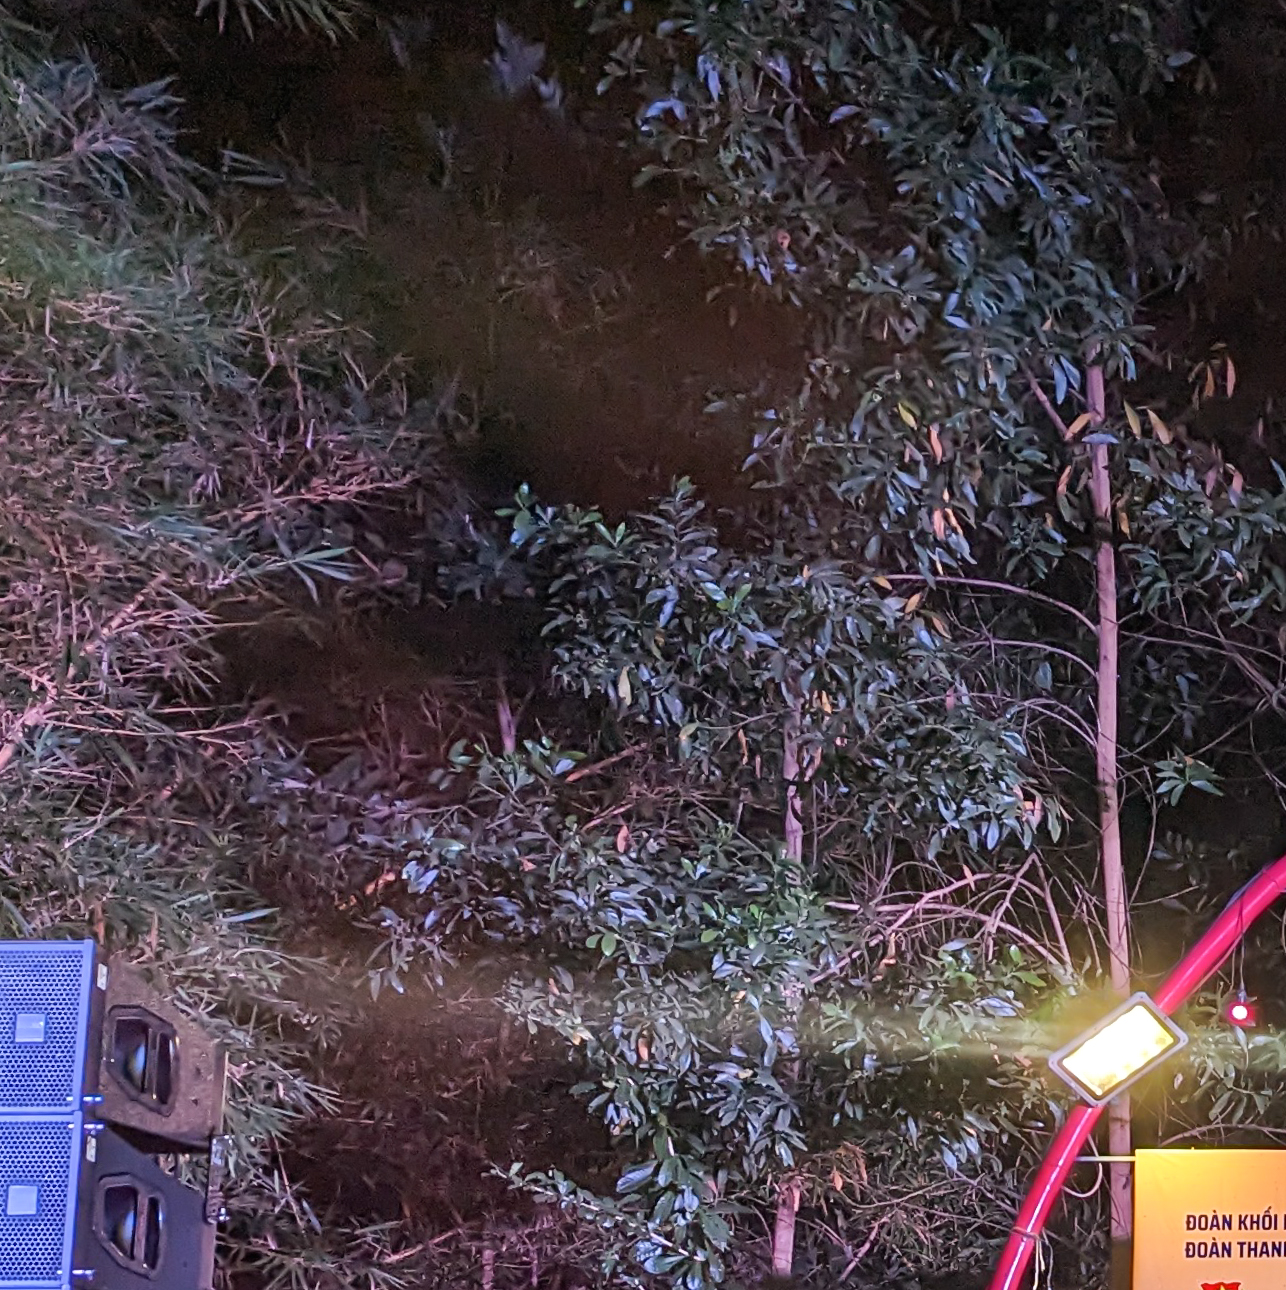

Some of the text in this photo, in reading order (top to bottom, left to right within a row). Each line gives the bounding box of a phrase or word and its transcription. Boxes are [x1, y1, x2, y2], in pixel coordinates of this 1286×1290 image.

[1186, 1209, 1232, 1230] ĐOÀN
[1238, 1206, 1278, 1230] KHỐI
[1185, 1237, 1232, 1258] ĐOÀN
